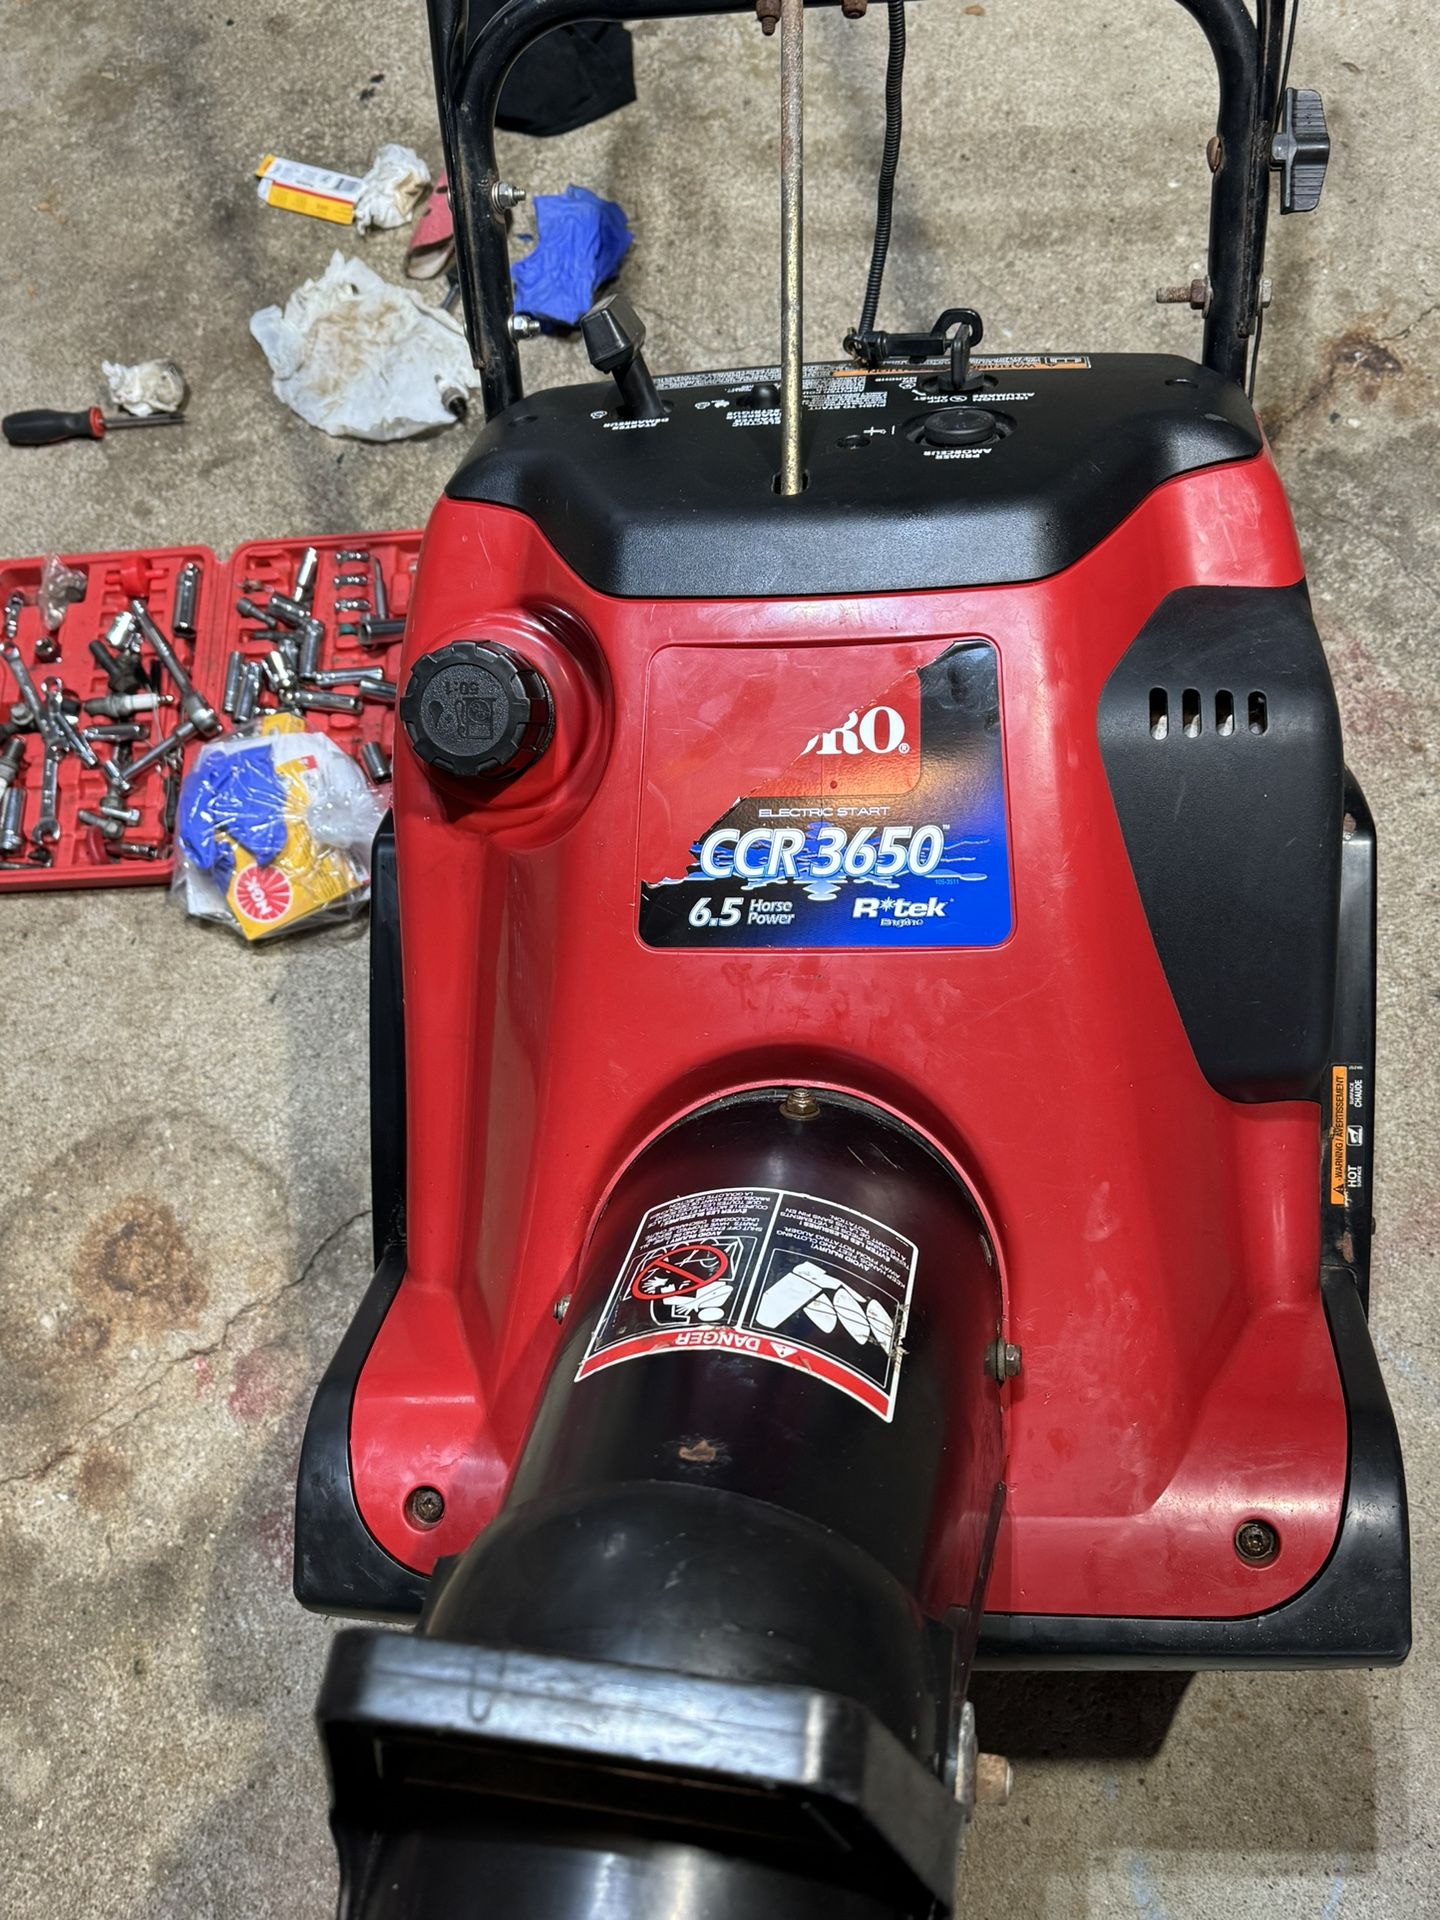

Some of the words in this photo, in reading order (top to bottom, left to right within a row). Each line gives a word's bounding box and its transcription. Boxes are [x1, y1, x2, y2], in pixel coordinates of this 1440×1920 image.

[924, 448, 992, 456] AMORCEUR
[936, 452, 980, 460] PRIMER
[758, 808, 833, 818] ELECTRIC
[836, 806, 891, 817] START
[700, 828, 806, 879] CCR
[808, 825, 945, 878] 3650
[688, 897, 745, 927] 6.5
[749, 898, 793, 912] Horse
[747, 911, 796, 926] Power
[880, 918, 924, 928] Engine
[1354, 1080, 1362, 1108] CHAUDE
[1335, 1076, 1344, 1138] AVERTISSEMENT
[1335, 1142, 1344, 1178] WARNING
[1348, 1165, 1357, 1188] HOT
[812, 1214, 834, 1224] SANS
[776, 1230, 818, 1244] CLOTHING
[804, 1221, 849, 1240] BLESSURES
[841, 1229, 863, 1241] PIEDS
[672, 1234, 697, 1242] INJURY
[815, 1234, 855, 1253] ROTATING
[819, 1240, 836, 1249] AND
[850, 1237, 864, 1247] LES
[837, 1248, 857, 1259] FEET
[856, 1251, 878, 1265] FROM
[844, 1256, 870, 1271] AVOID
[880, 1264, 900, 1278] AWAY
[887, 1275, 905, 1288] KEEP
[675, 1331, 760, 1351] DANGER
